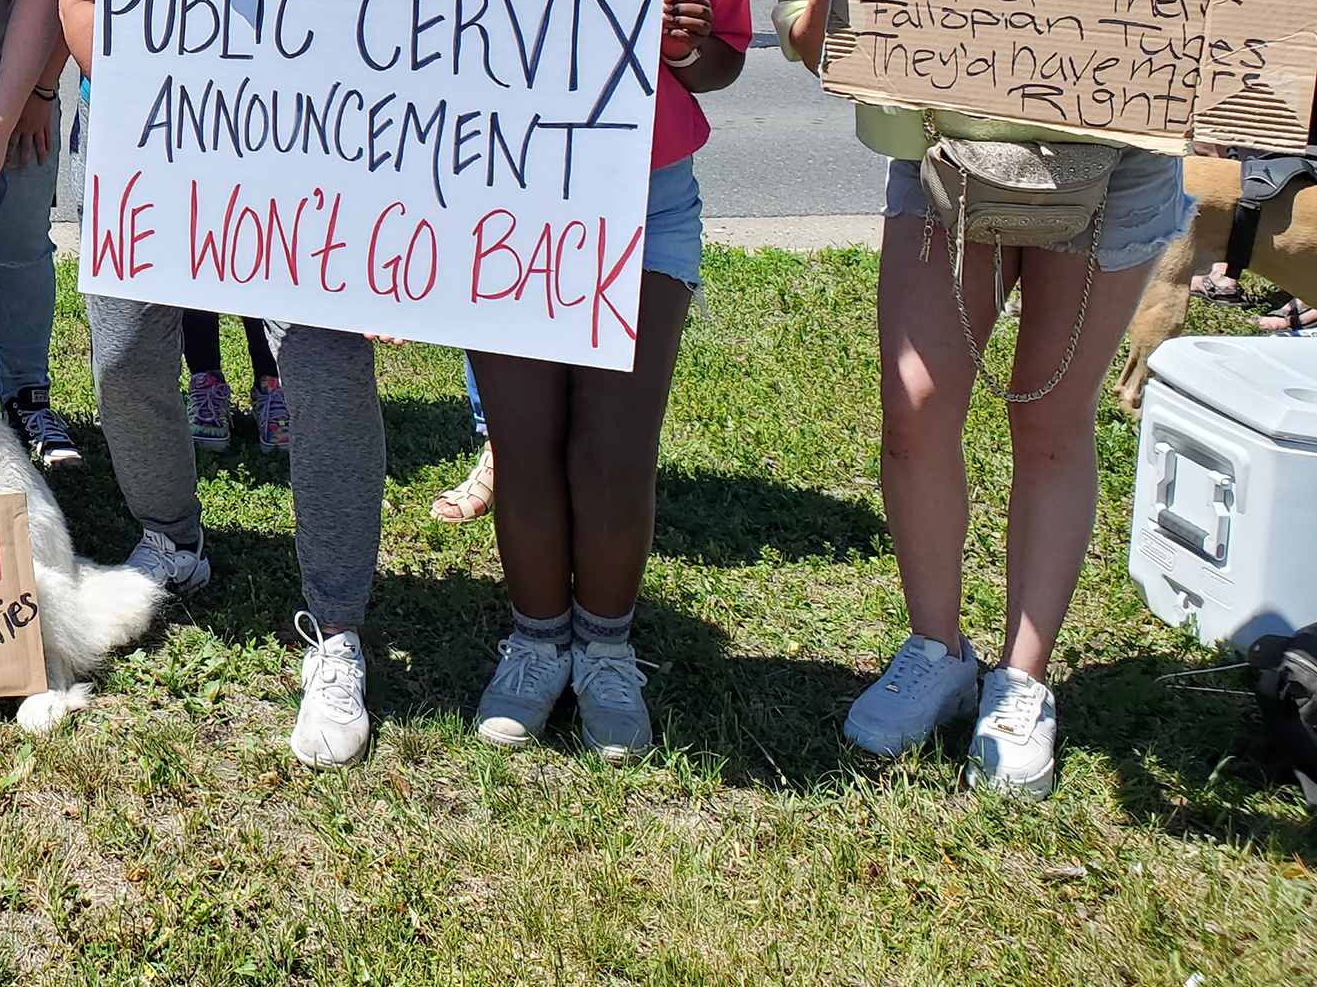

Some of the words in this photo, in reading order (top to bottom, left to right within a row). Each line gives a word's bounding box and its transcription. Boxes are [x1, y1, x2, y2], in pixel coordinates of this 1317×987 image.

[856, 31, 997, 90] They'd
[1012, 38, 1120, 87] have
[1130, 58, 1262, 94] more
[1098, 18, 1269, 70] Tubes
[137, 74, 638, 209] ANNOUNCEMENT
[92, 170, 156, 282] WE
[367, 201, 438, 303] GO
[470, 209, 644, 349] BACK
